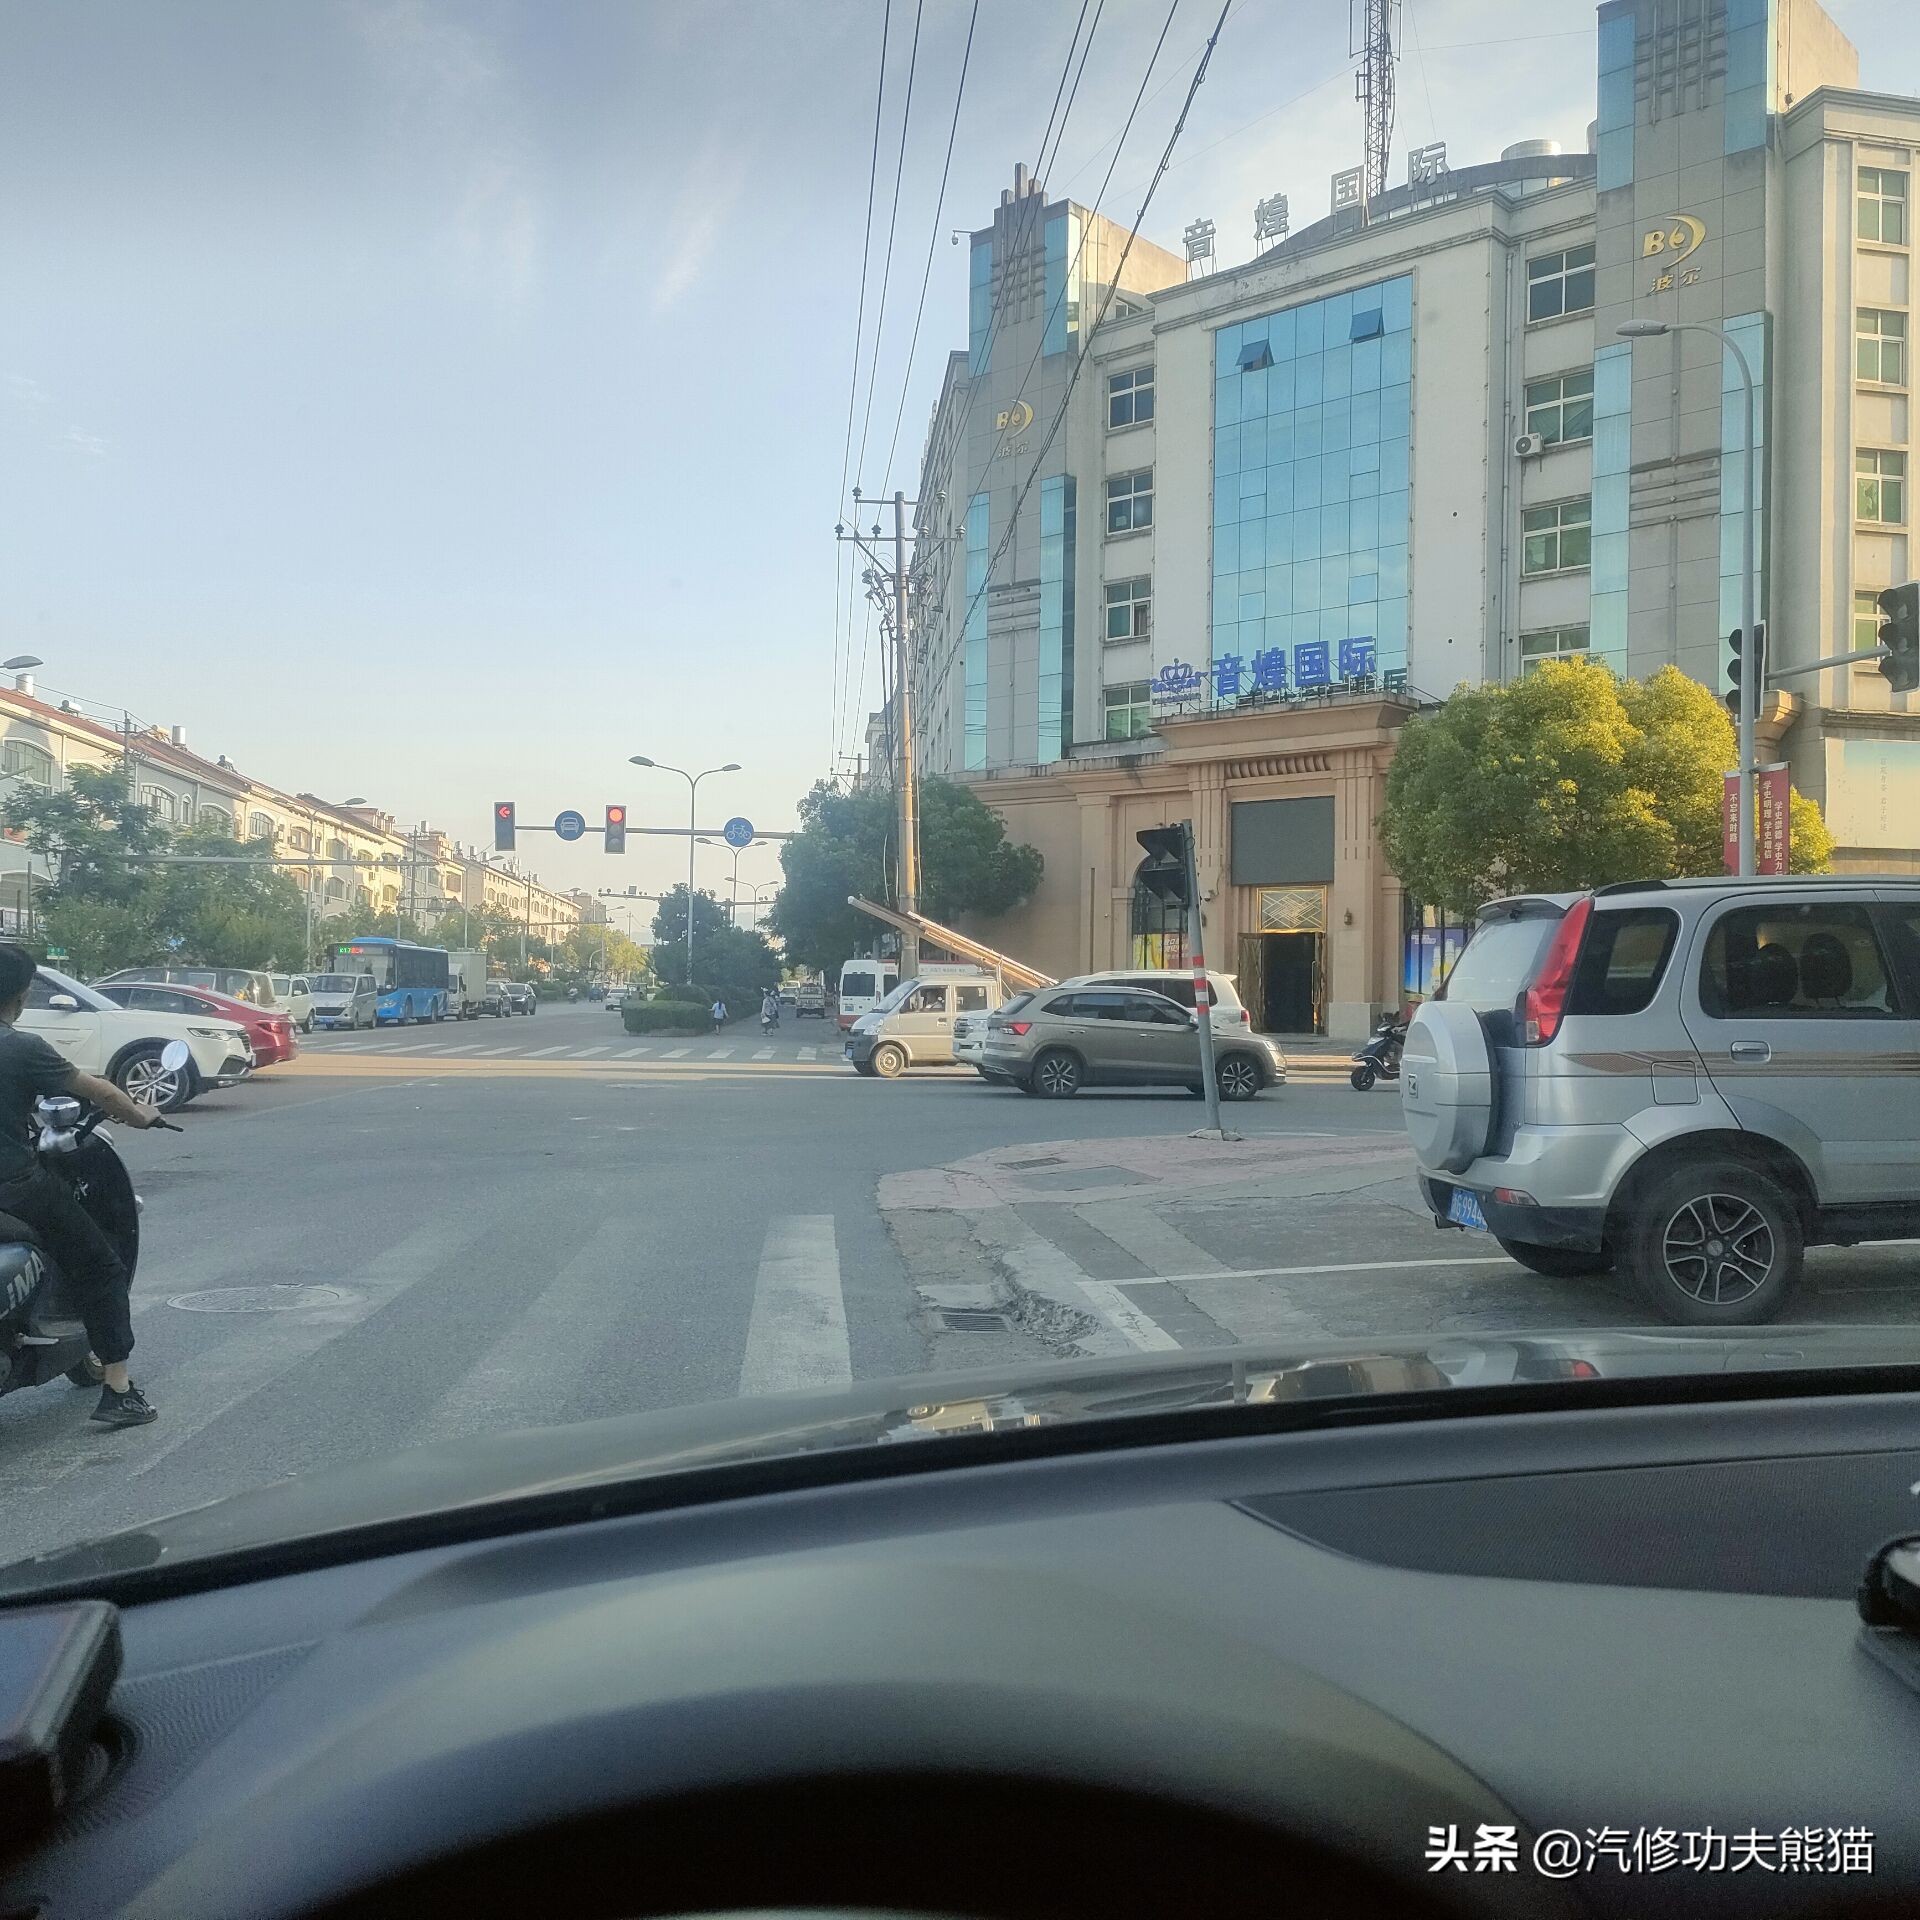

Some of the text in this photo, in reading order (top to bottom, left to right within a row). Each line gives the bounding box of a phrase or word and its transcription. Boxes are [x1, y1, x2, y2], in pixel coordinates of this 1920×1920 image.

[1182, 141, 1450, 262] 音煌国际
[1647, 266, 1702, 295] 波尔
[1211, 635, 1377, 697] 音煌国际
[1729, 793, 1738, 843] 不忘来时路
[1762, 780, 1773, 860] 学史明理 学史增信
